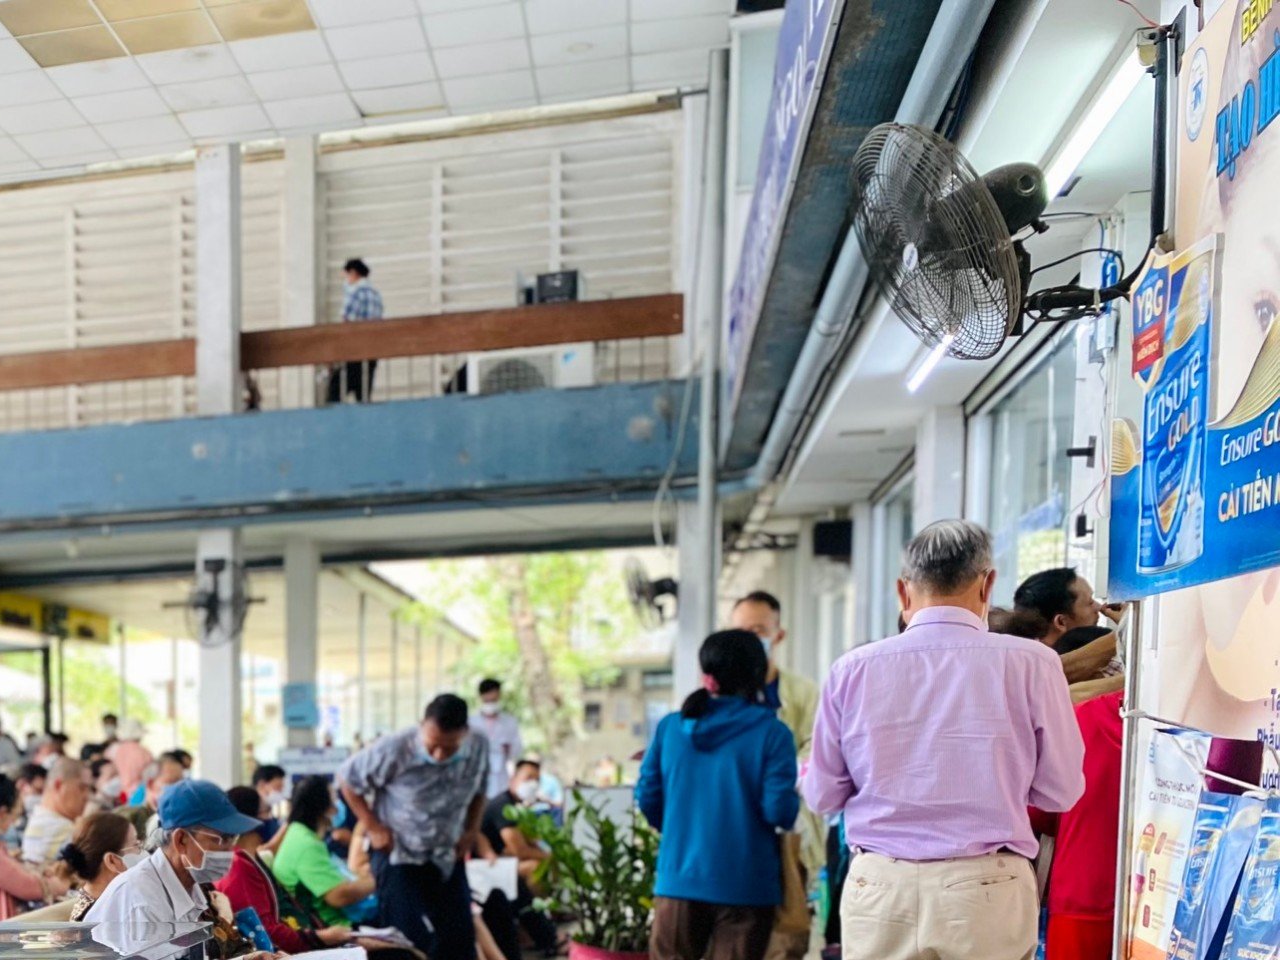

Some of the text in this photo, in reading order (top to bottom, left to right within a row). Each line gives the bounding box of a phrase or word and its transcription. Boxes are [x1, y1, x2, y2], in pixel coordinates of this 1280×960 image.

[1137, 278, 1163, 328] YBG
[1147, 350, 1200, 442] Ensure
[1168, 395, 1199, 452] GOLD
[1220, 427, 1262, 466] Ensure
[1218, 468, 1272, 523] CẢI TIẾN
